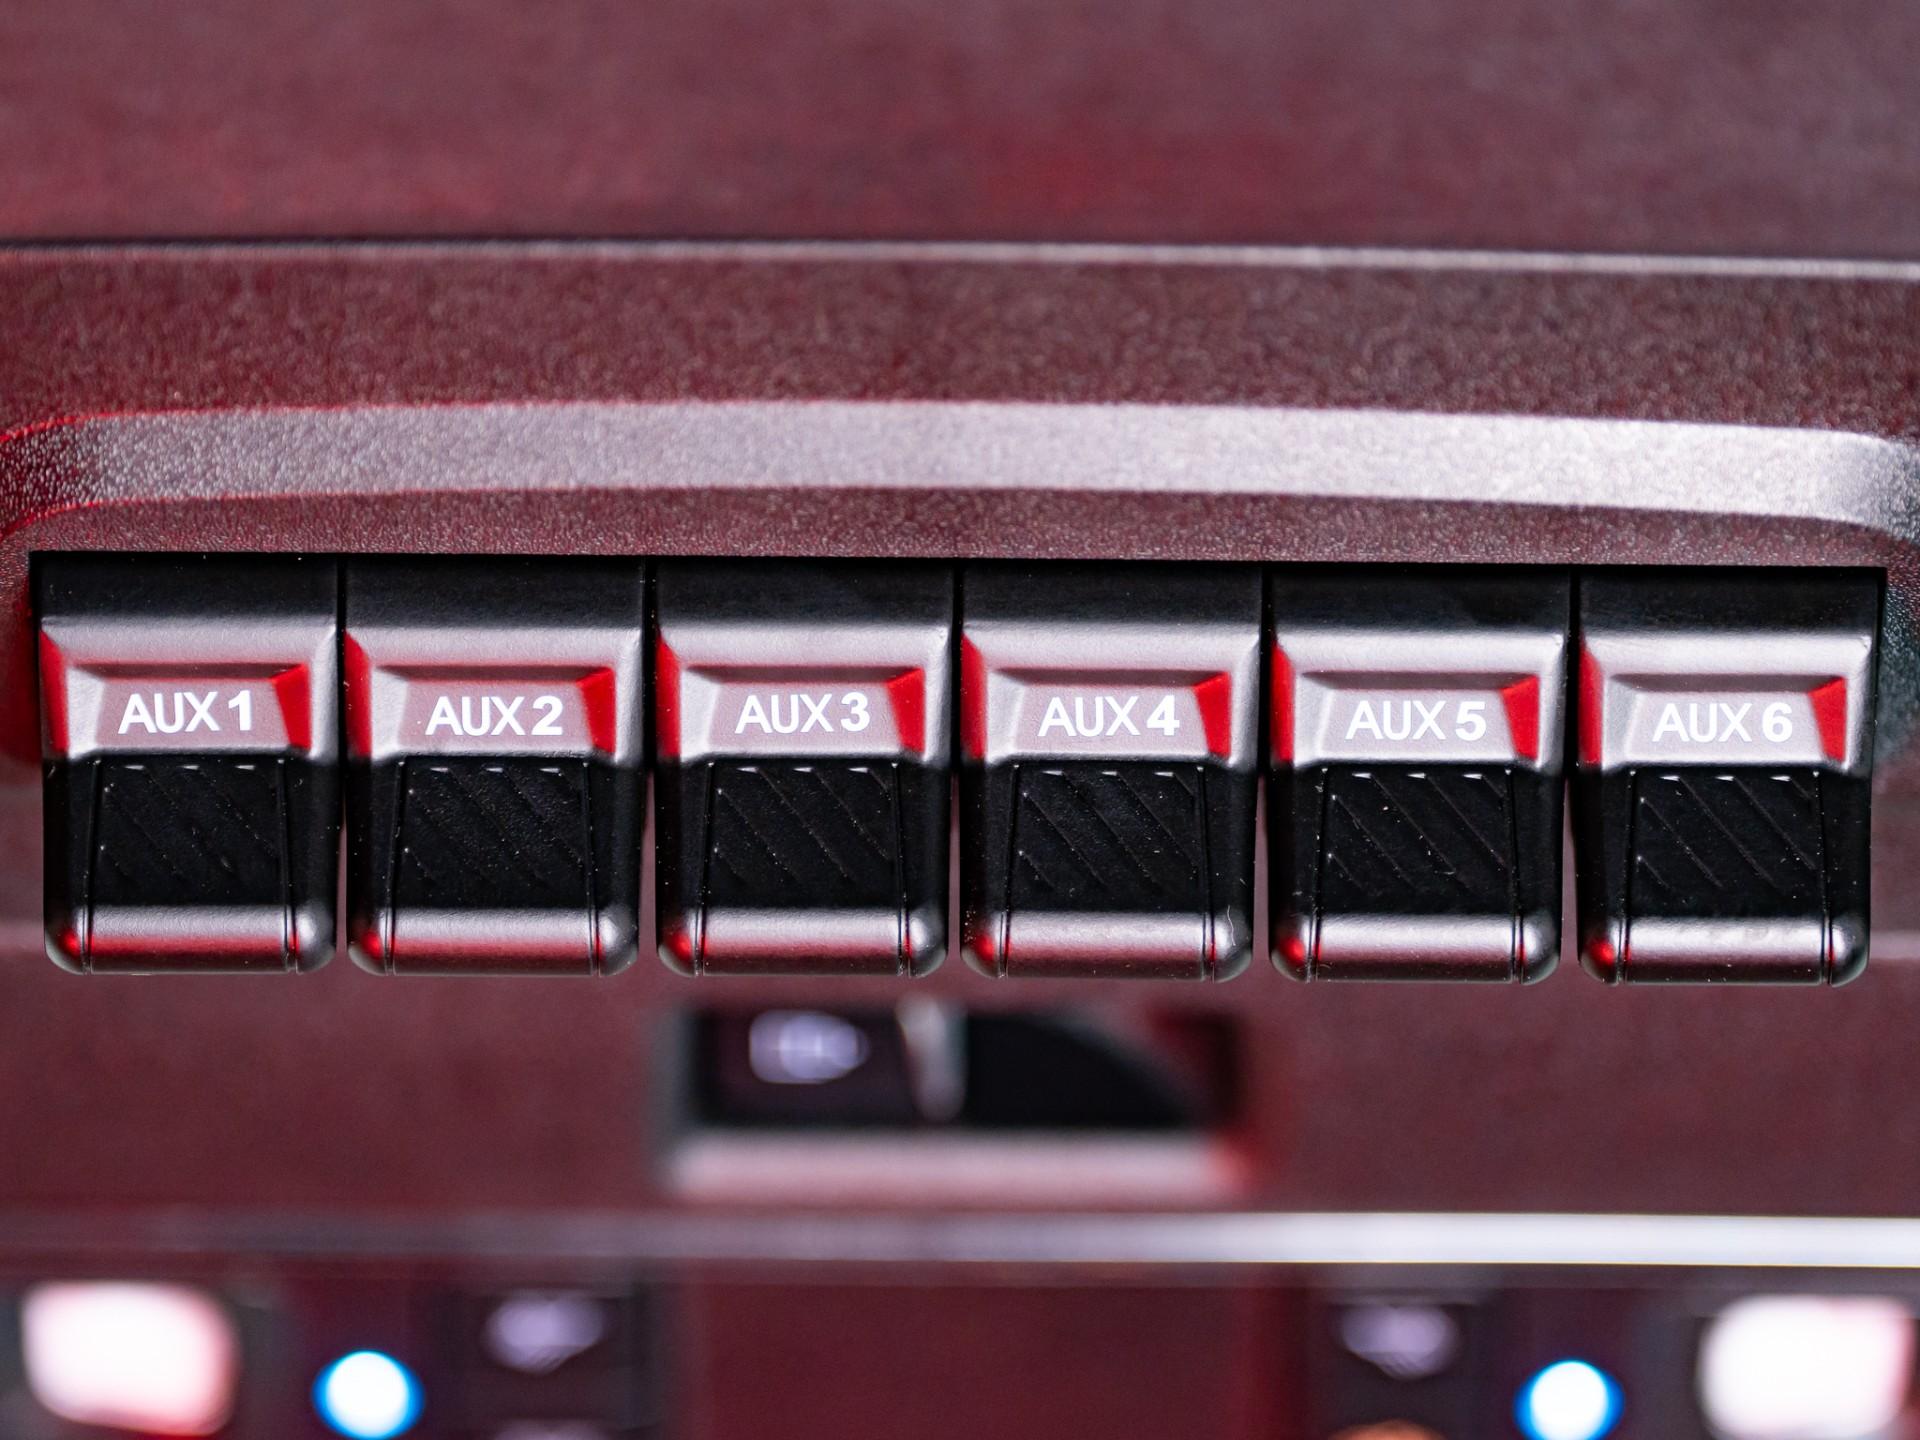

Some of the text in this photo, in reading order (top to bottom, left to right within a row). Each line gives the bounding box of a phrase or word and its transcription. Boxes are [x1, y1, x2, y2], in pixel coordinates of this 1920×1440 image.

[117, 689, 252, 734] AUX 1
[425, 695, 564, 737] AUX 2
[734, 691, 871, 734] AUX 3
[1037, 693, 1180, 737] AUX 4
[1344, 699, 1487, 741] AUX 5
[1652, 702, 1794, 742] AUX 6
